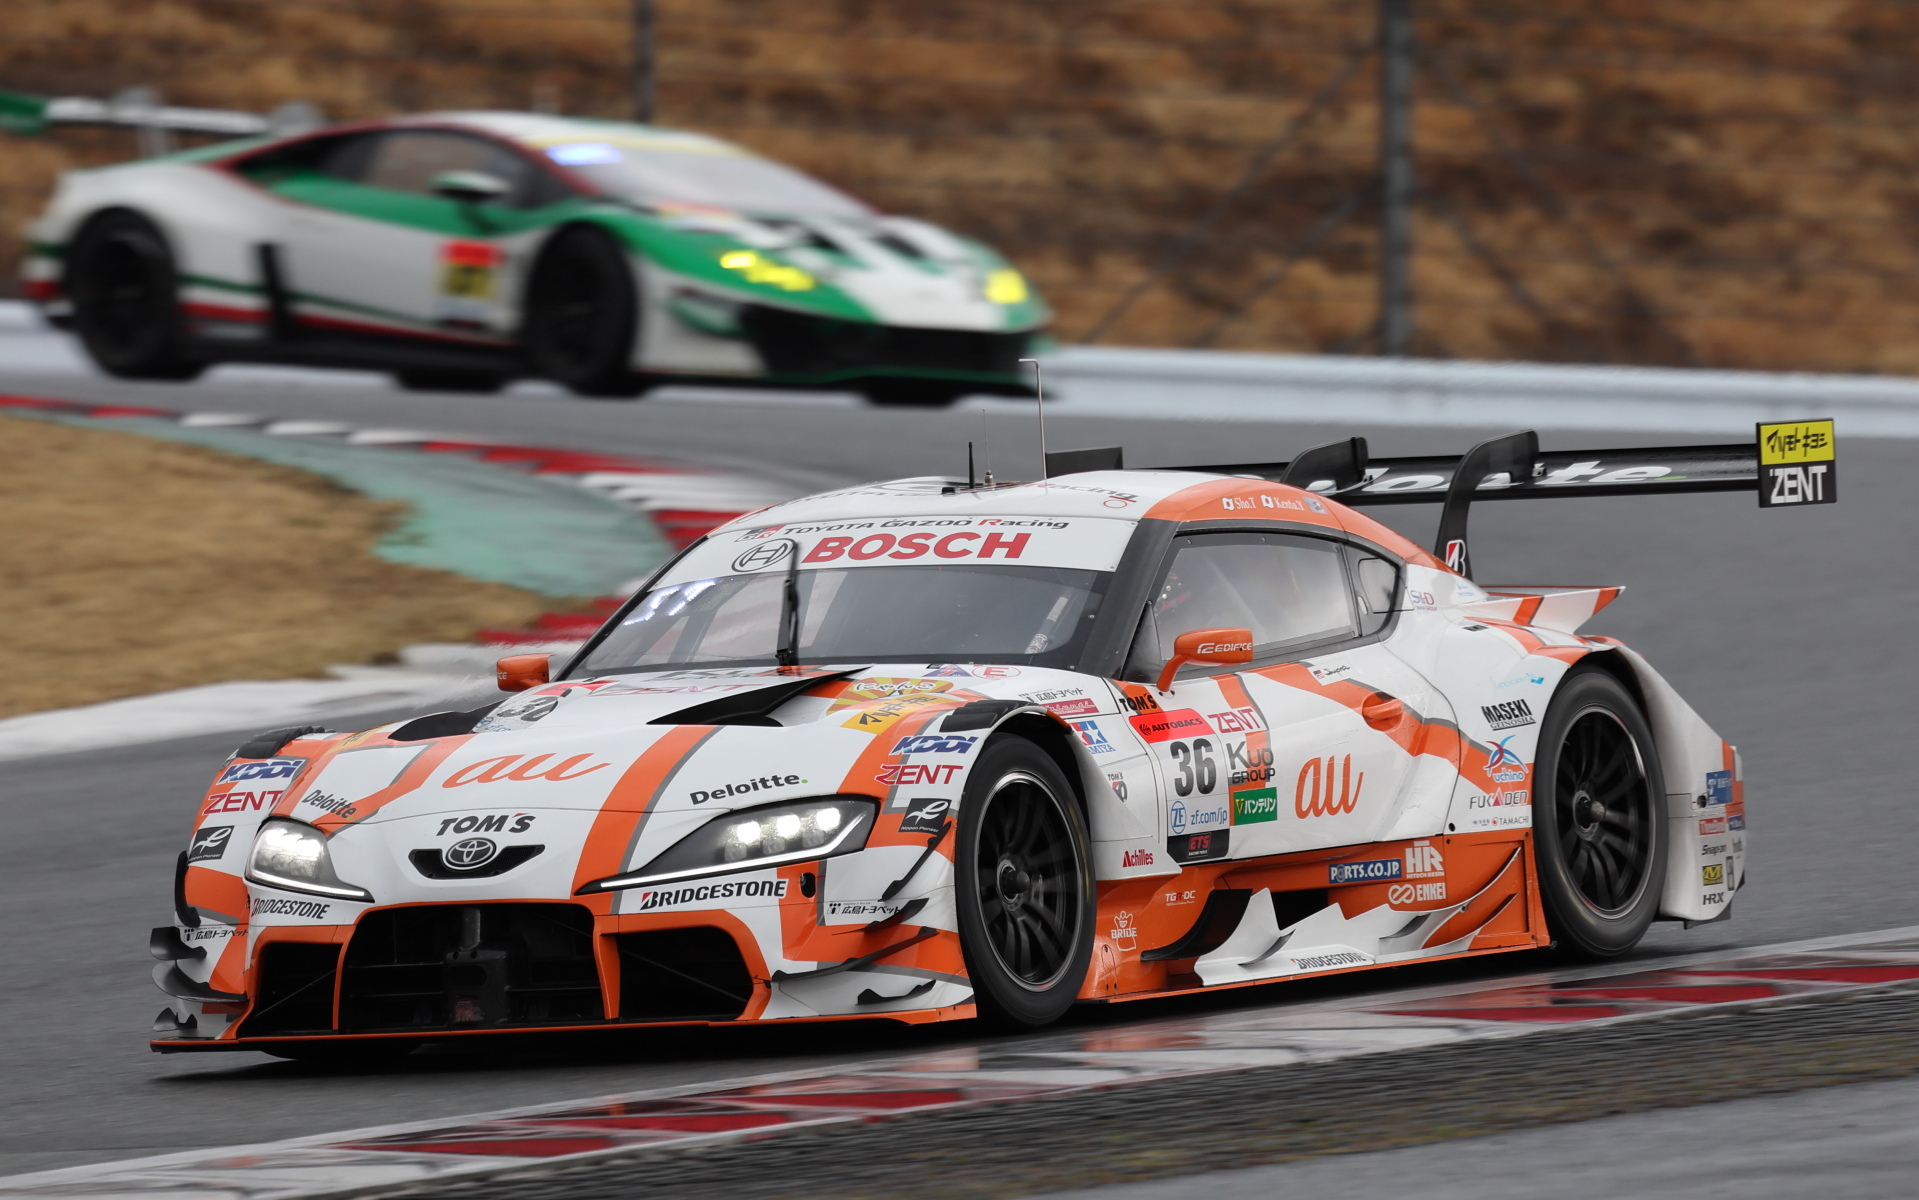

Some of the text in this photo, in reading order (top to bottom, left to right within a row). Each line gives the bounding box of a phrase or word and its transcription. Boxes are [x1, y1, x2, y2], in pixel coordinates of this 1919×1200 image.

[1766, 426, 1828, 460] マツモトキヨシ
[1769, 465, 1827, 504] ZENT
[784, 521, 874, 535] TOYOTA
[880, 519, 972, 529] GAZOO
[978, 518, 1069, 530] Racing
[801, 533, 1032, 564] BOSCH
[1214, 643, 1252, 653] EDIFICE
[1118, 693, 1158, 712] TOM'S
[1481, 699, 1532, 723] MASEKI
[1152, 718, 1203, 732] AUTOBACS
[1208, 708, 1261, 733] ZENT
[1490, 716, 1535, 729] GEINOSHA
[889, 736, 979, 755] KDDI
[216, 761, 306, 785] KDDI
[441, 753, 612, 788] au
[875, 764, 963, 785] ZENT
[1170, 739, 1217, 797] 36
[1232, 767, 1276, 784] GROUP
[1493, 768, 1525, 781] uchino
[1295, 753, 1364, 819] au
[203, 790, 285, 815] ZENT
[1469, 791, 1528, 809] FUKADEN
[436, 813, 536, 836] TOM'S
[1171, 807, 1228, 827] ZF zf.com/jp
[1499, 816, 1529, 825] TAMACHI
[1123, 849, 1153, 867] Achilles
[640, 880, 786, 910] BRIDGESTONE
[1165, 890, 1196, 902] TGR-DC
[1417, 883, 1446, 901] ENKEI
[1703, 892, 1725, 905] HRX
[251, 898, 330, 919] BRIDGESTONE
[1111, 927, 1137, 938] BRIDE
[1290, 952, 1367, 969] BRIDGESTONE
